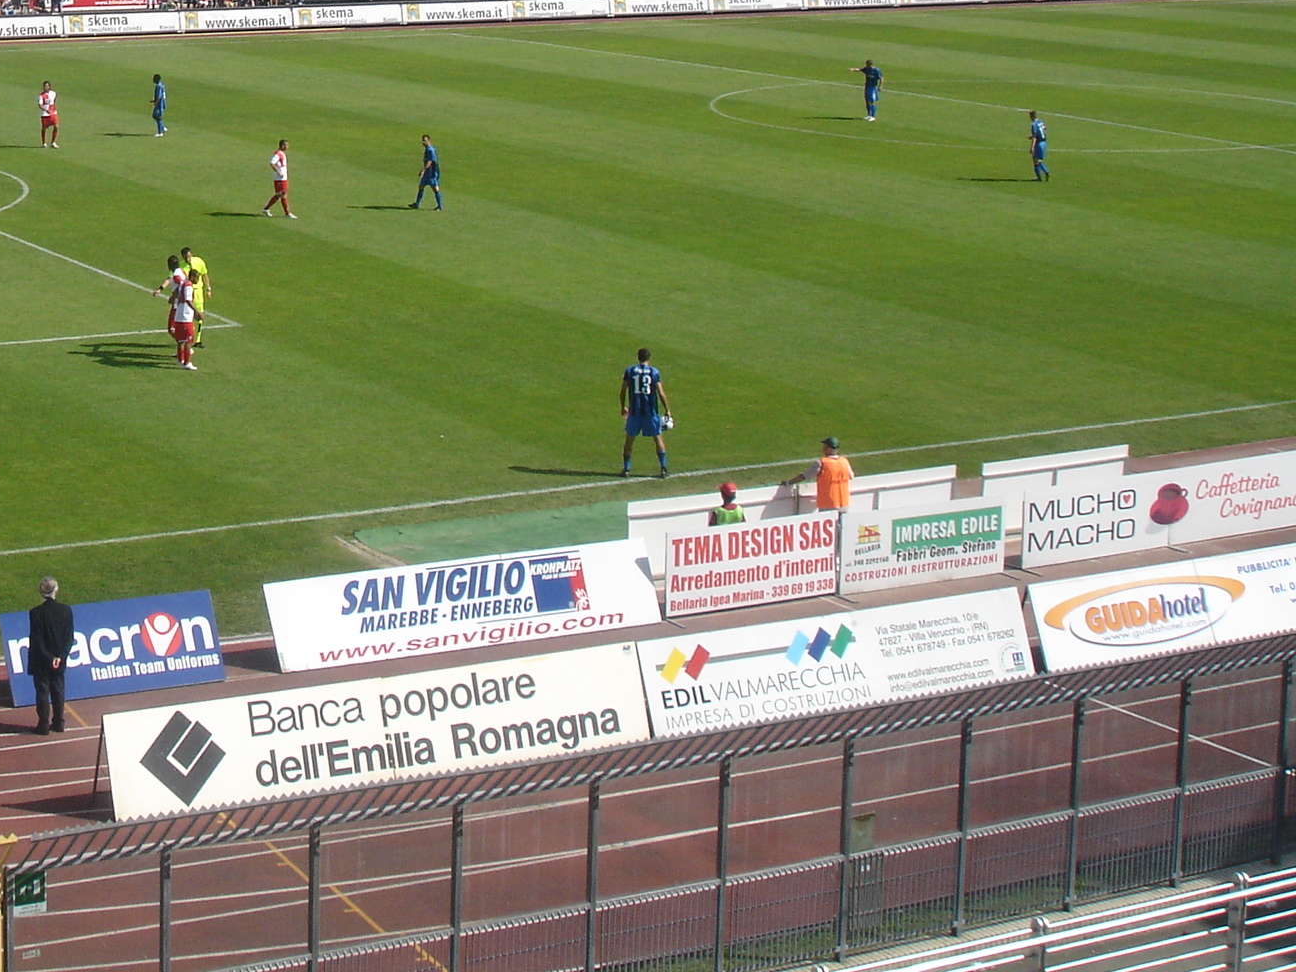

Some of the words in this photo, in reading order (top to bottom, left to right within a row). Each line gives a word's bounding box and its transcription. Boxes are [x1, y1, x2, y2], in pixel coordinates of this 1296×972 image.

[316, 7, 354, 19] skema
[425, 6, 502, 20] www.skema.it
[529, 0, 564, 11] skema
[88, 15, 128, 27] skema
[205, 15, 287, 29] www.skema.it
[632, 375, 652, 395] 13
[1195, 473, 1280, 500] Caffetteria
[1028, 489, 1136, 523] MUCHO
[671, 536, 723, 568] TEMA
[727, 526, 794, 560] DESIGN
[798, 518, 834, 551] SAS
[895, 519, 956, 545] IMPRESA
[960, 514, 999, 536] EDILE
[1028, 518, 1135, 553] MACHO
[896, 546, 926, 563] Fabbri
[929, 543, 959, 557] Geom.
[962, 539, 996, 554] Stefano
[530, 560, 582, 576] KRONPLATZ
[670, 563, 770, 594] Arredamento
[773, 552, 834, 579] d'interni
[844, 568, 908, 583] COSTRUZIONI
[911, 553, 999, 574] RISTRUTTURAZIONI
[341, 575, 405, 616] SAN
[414, 560, 526, 605] VIGILIO
[670, 594, 707, 612] Bellaria
[709, 592, 730, 608] Igea
[732, 588, 764, 605] Marina
[771, 583, 791, 599] 339
[793, 582, 803, 596] 69
[805, 580, 814, 594] 19
[1269, 583, 1286, 594] Tel.
[359, 609, 438, 634] MAREBBE
[450, 596, 534, 622] ENNEBERG
[1085, 587, 1209, 635] GUIDAhotel
[319, 611, 625, 663] www.sanvigilio.com
[875, 626, 889, 636] Via
[890, 621, 918, 634] Statale
[908, 631, 926, 643] Villa
[926, 626, 966, 640] Verucchio
[952, 637, 966, 648] Fax
[1102, 619, 1207, 642] www.guidahotel.com
[91, 664, 131, 682] Italian
[135, 659, 166, 676] Team
[167, 652, 220, 672] Uniforms
[886, 657, 990, 682] www.edilvalmarecchia.com
[246, 691, 363, 738] Banca
[379, 671, 536, 721] popolare
[665, 708, 733, 730] IMPRESA
[740, 703, 756, 720] DI
[762, 683, 873, 716] COSTRUZIONI
[256, 730, 436, 787] dell'Emilia
[452, 706, 622, 758] Romagna
